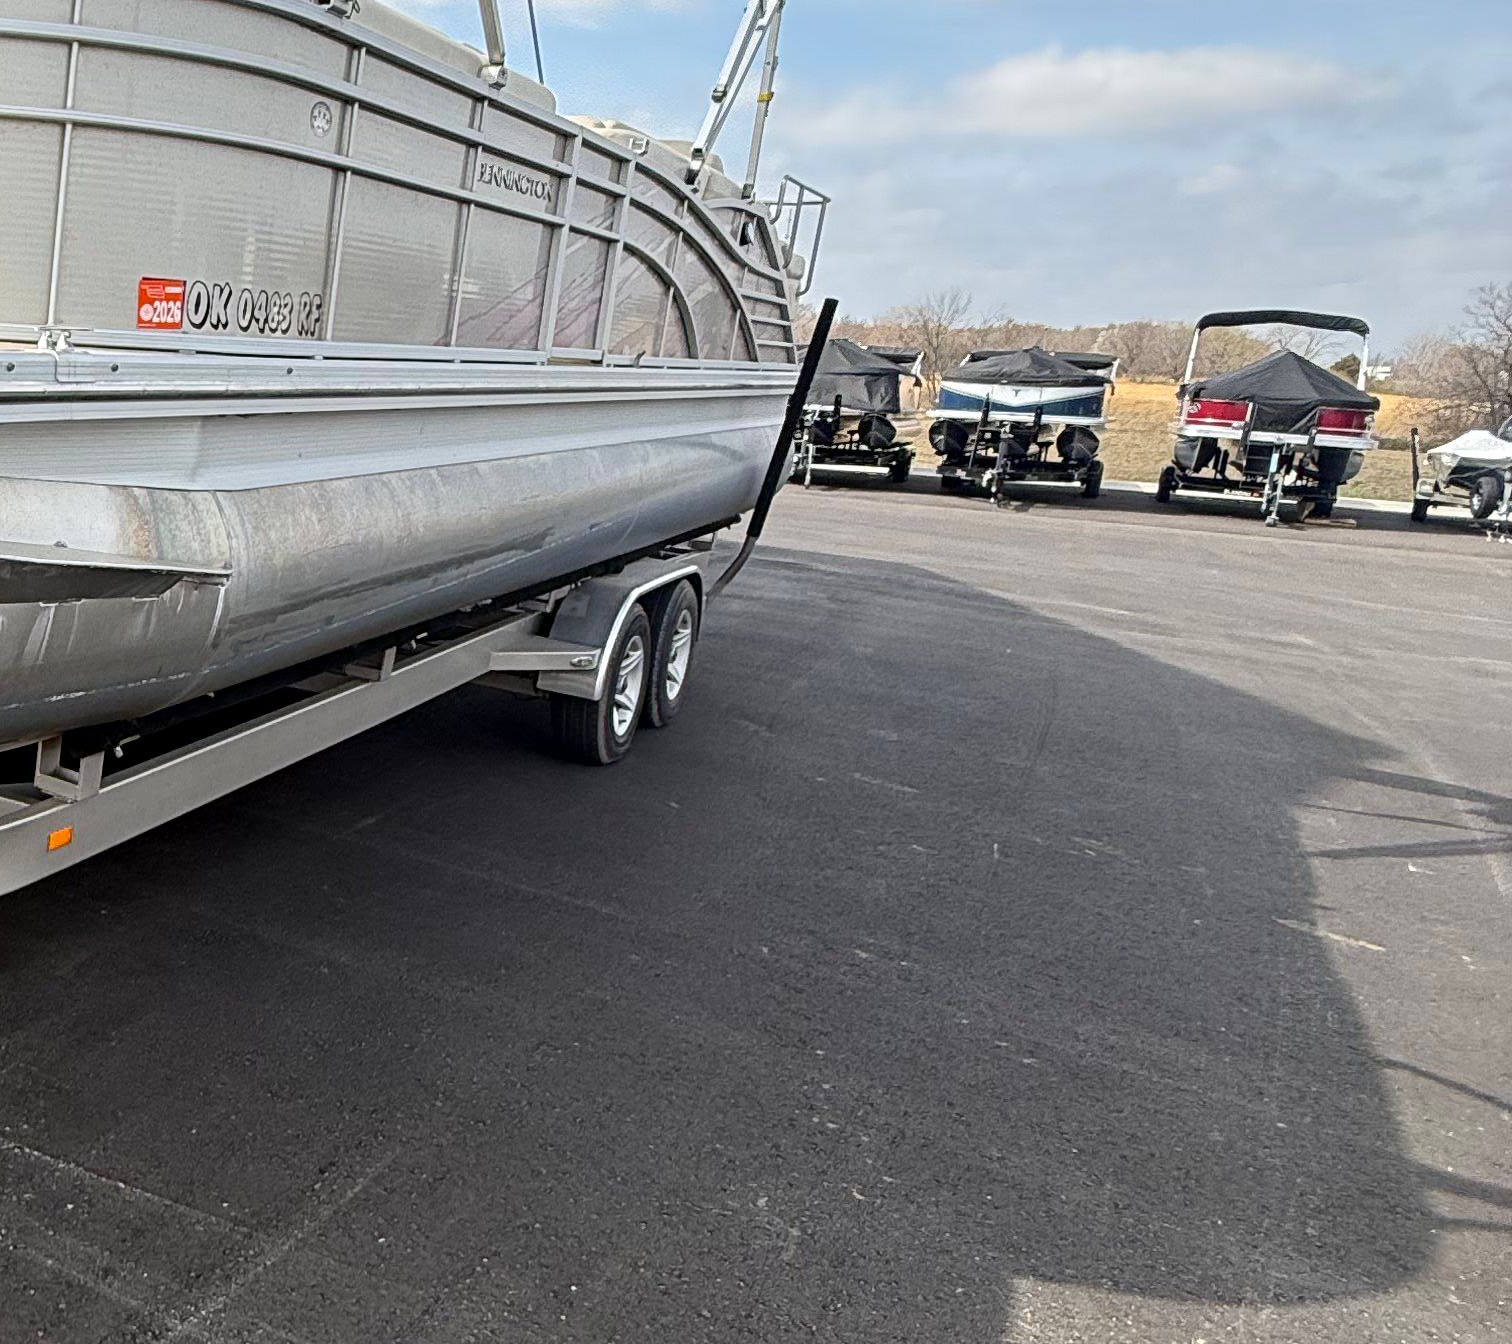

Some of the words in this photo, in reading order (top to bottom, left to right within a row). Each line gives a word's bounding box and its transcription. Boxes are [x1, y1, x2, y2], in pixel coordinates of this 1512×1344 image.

[477, 162, 553, 203] BENNINGTON
[152, 300, 182, 324] 2026
[188, 280, 233, 330] OK
[238, 288, 294, 335] 0483
[297, 291, 323, 337] RF
